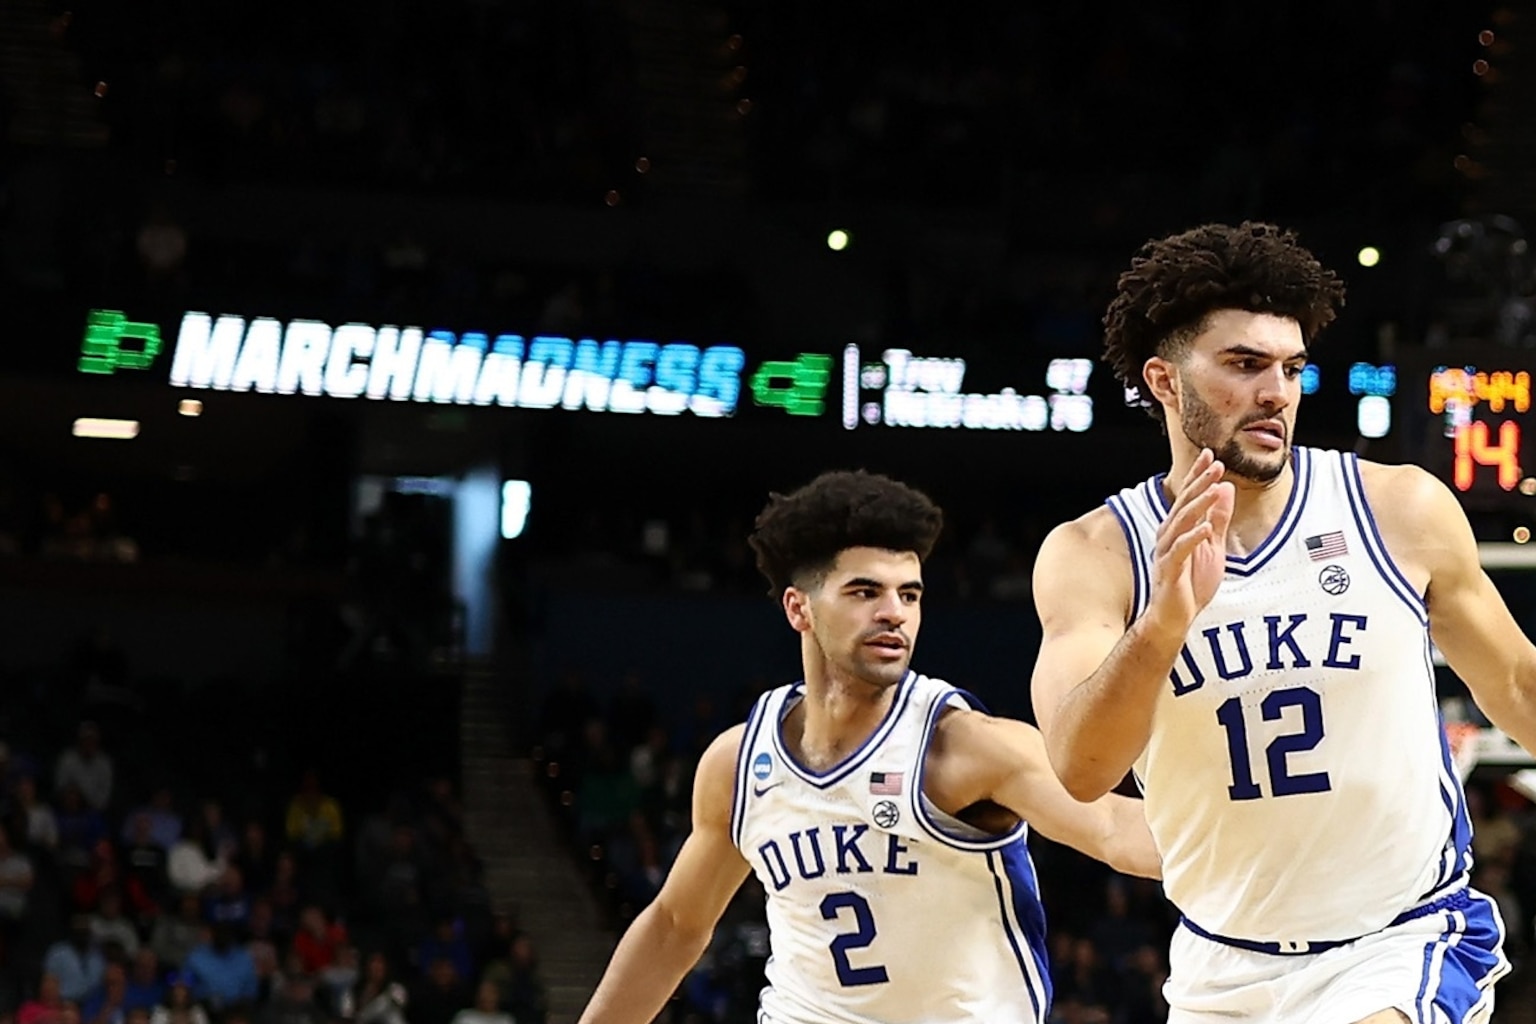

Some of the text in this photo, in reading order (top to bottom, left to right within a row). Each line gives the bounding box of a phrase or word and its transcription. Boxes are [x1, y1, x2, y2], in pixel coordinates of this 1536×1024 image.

[1454, 420, 1521, 491] 14
[1216, 686, 1332, 802] 12
[758, 823, 919, 891] DUKE
[819, 891, 890, 987] 2
